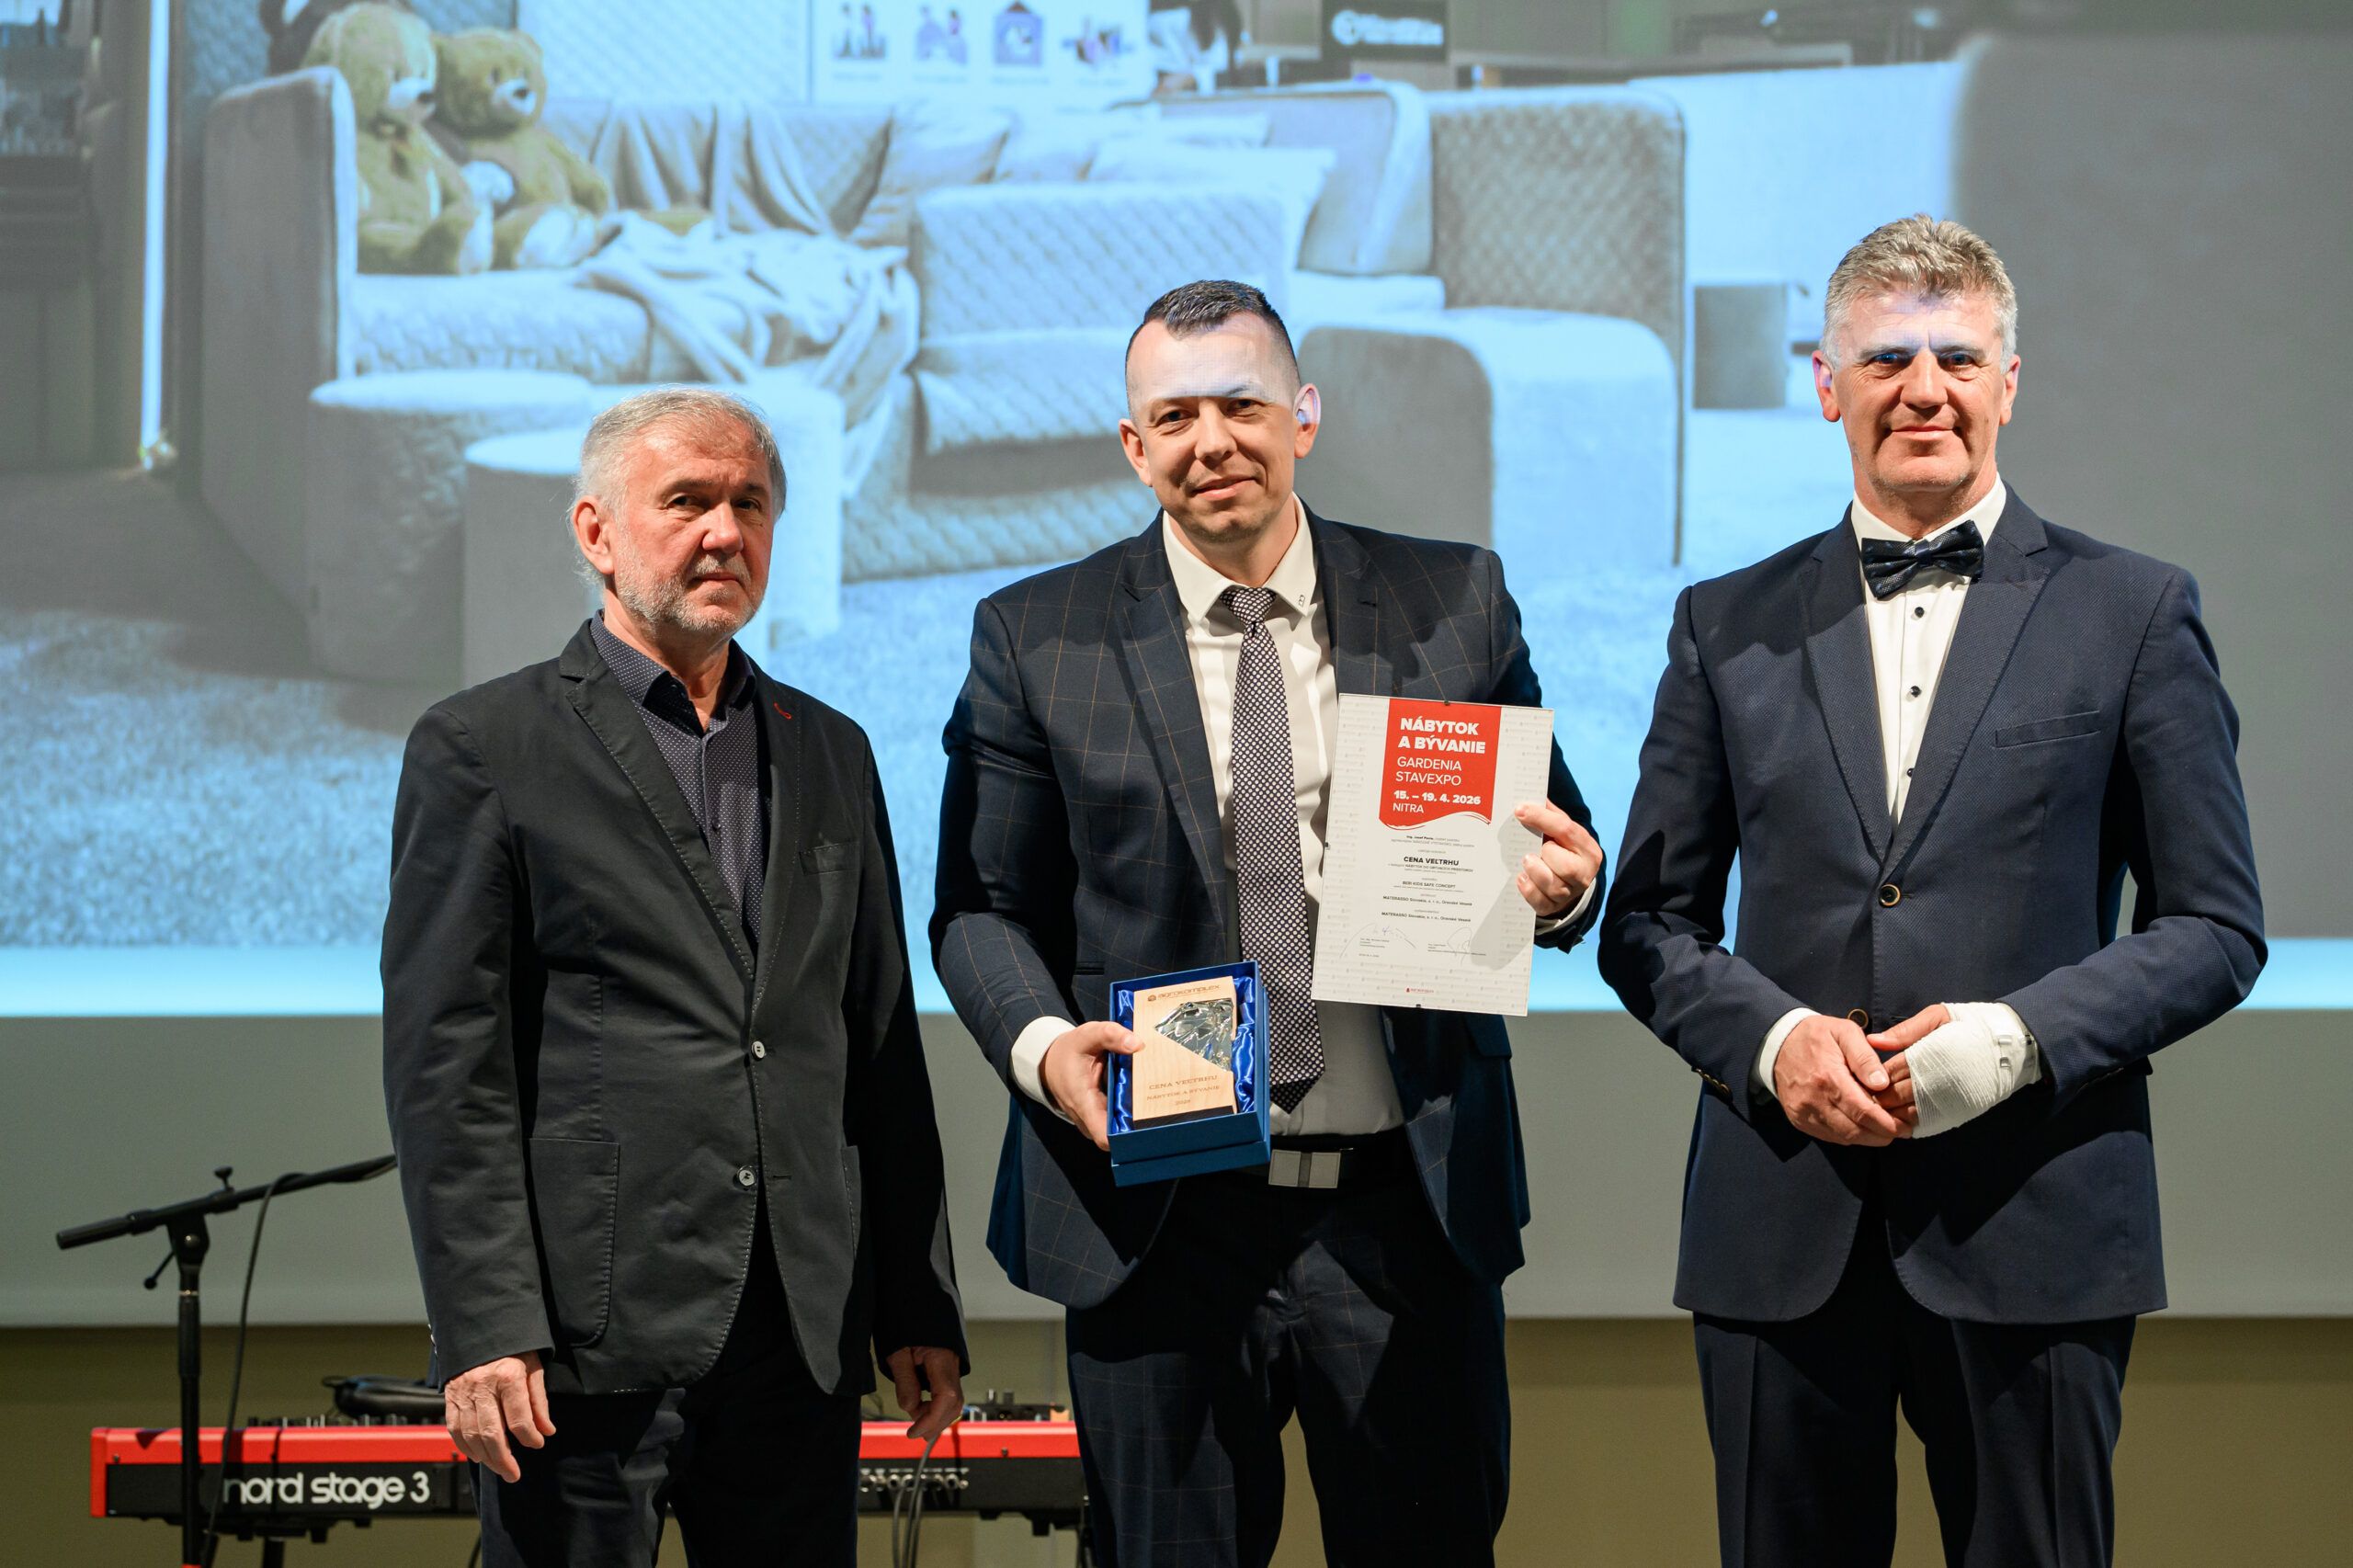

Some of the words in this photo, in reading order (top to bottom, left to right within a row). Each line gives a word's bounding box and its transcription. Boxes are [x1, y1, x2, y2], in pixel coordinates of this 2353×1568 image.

[1400, 715, 1480, 736] NÁBYTOK
[1397, 736, 1411, 749] A
[1414, 735, 1486, 755] BÝVANIE
[1396, 756, 1462, 771] GARDENIA
[1395, 771, 1462, 786] STAVEXPO
[1393, 790, 1410, 801] 15.
[1422, 792, 1438, 802] 19.
[1439, 793, 1450, 803] 4.
[1452, 794, 1482, 805] 2026
[1392, 802, 1425, 813] NITRA
[1149, 1082, 1173, 1090] CENA
[223, 1471, 303, 1505] nord
[311, 1471, 404, 1509] stage
[410, 1471, 430, 1504] 3
